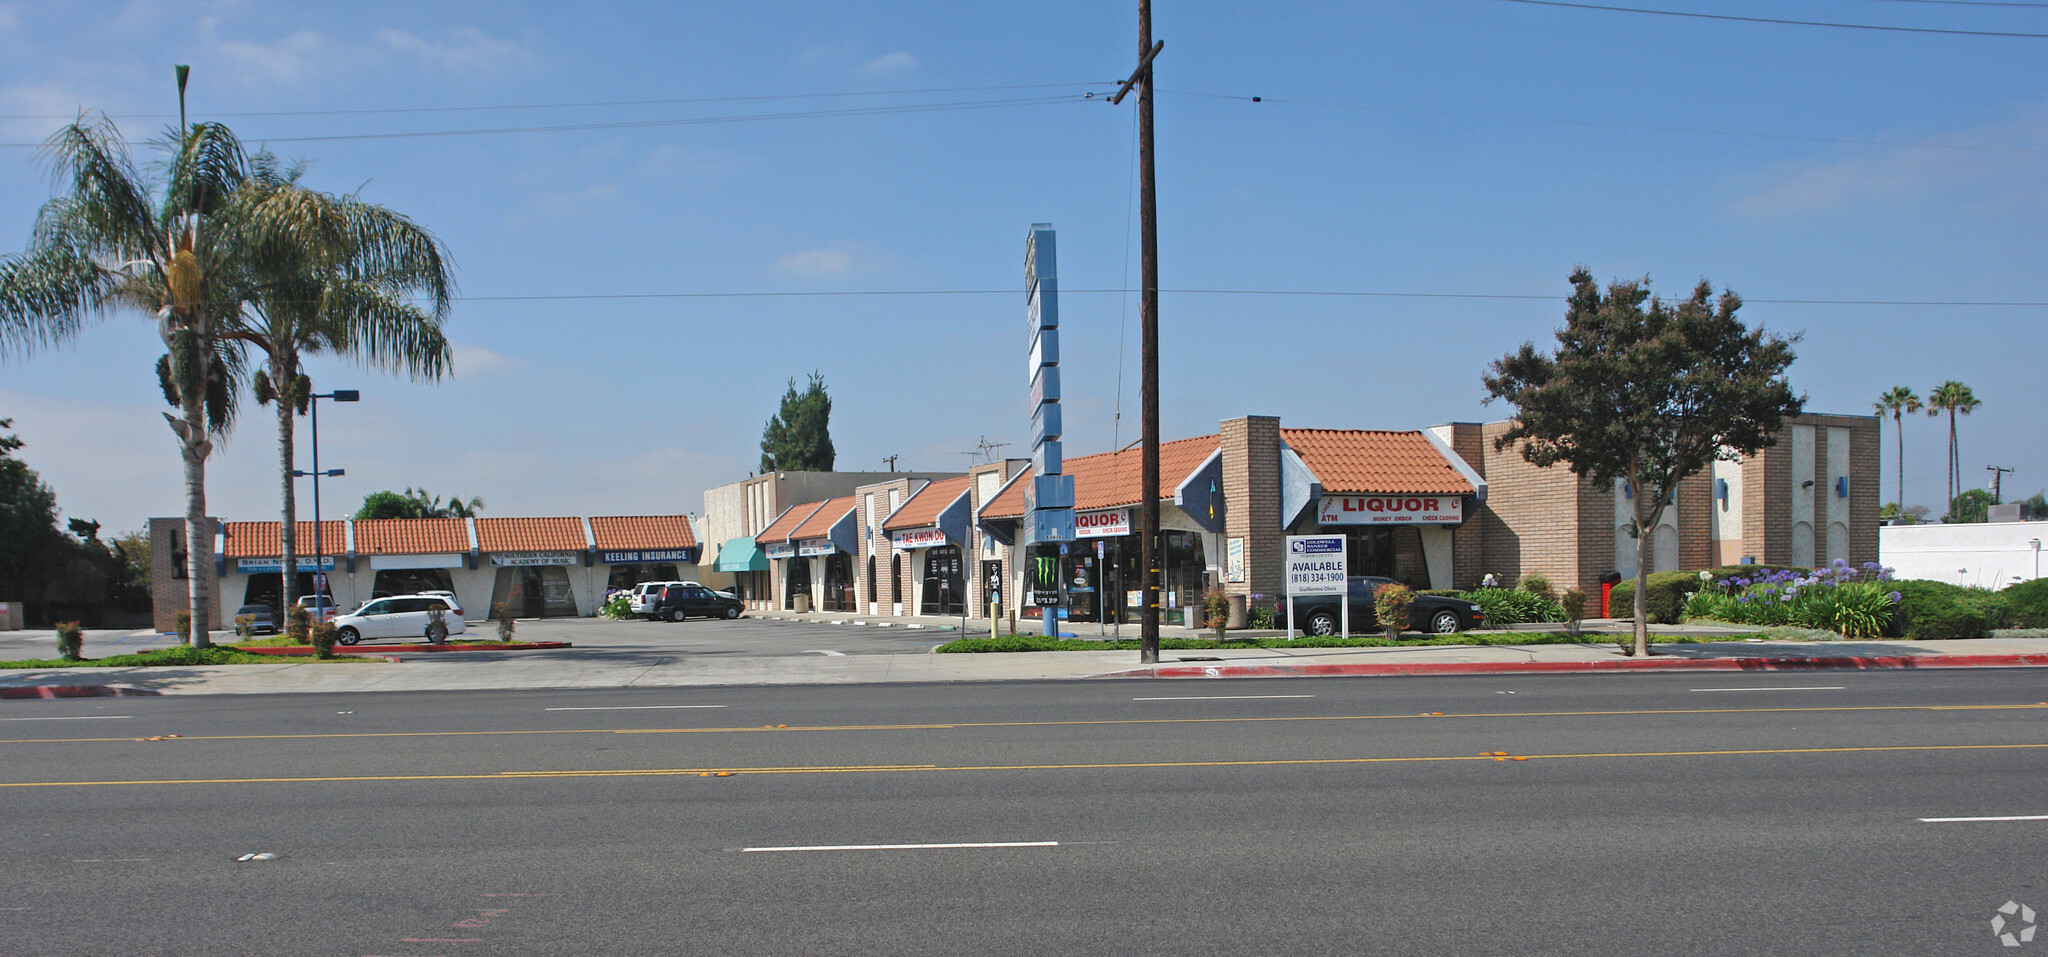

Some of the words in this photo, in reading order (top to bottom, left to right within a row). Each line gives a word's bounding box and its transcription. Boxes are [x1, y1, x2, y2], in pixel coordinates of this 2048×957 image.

[1321, 498, 1334, 514] LUCKY
[1342, 498, 1440, 512] LIQUOR
[1075, 513, 1119, 527] IQUOR
[902, 532, 913, 543] TAE
[914, 530, 934, 543] KWON
[604, 552, 639, 562] KEELING
[641, 550, 687, 561] INSURANCE
[1292, 561, 1343, 571] AVAILABLE
[1291, 573, 1310, 584] (818)
[1311, 572, 1344, 583] 334-1900
